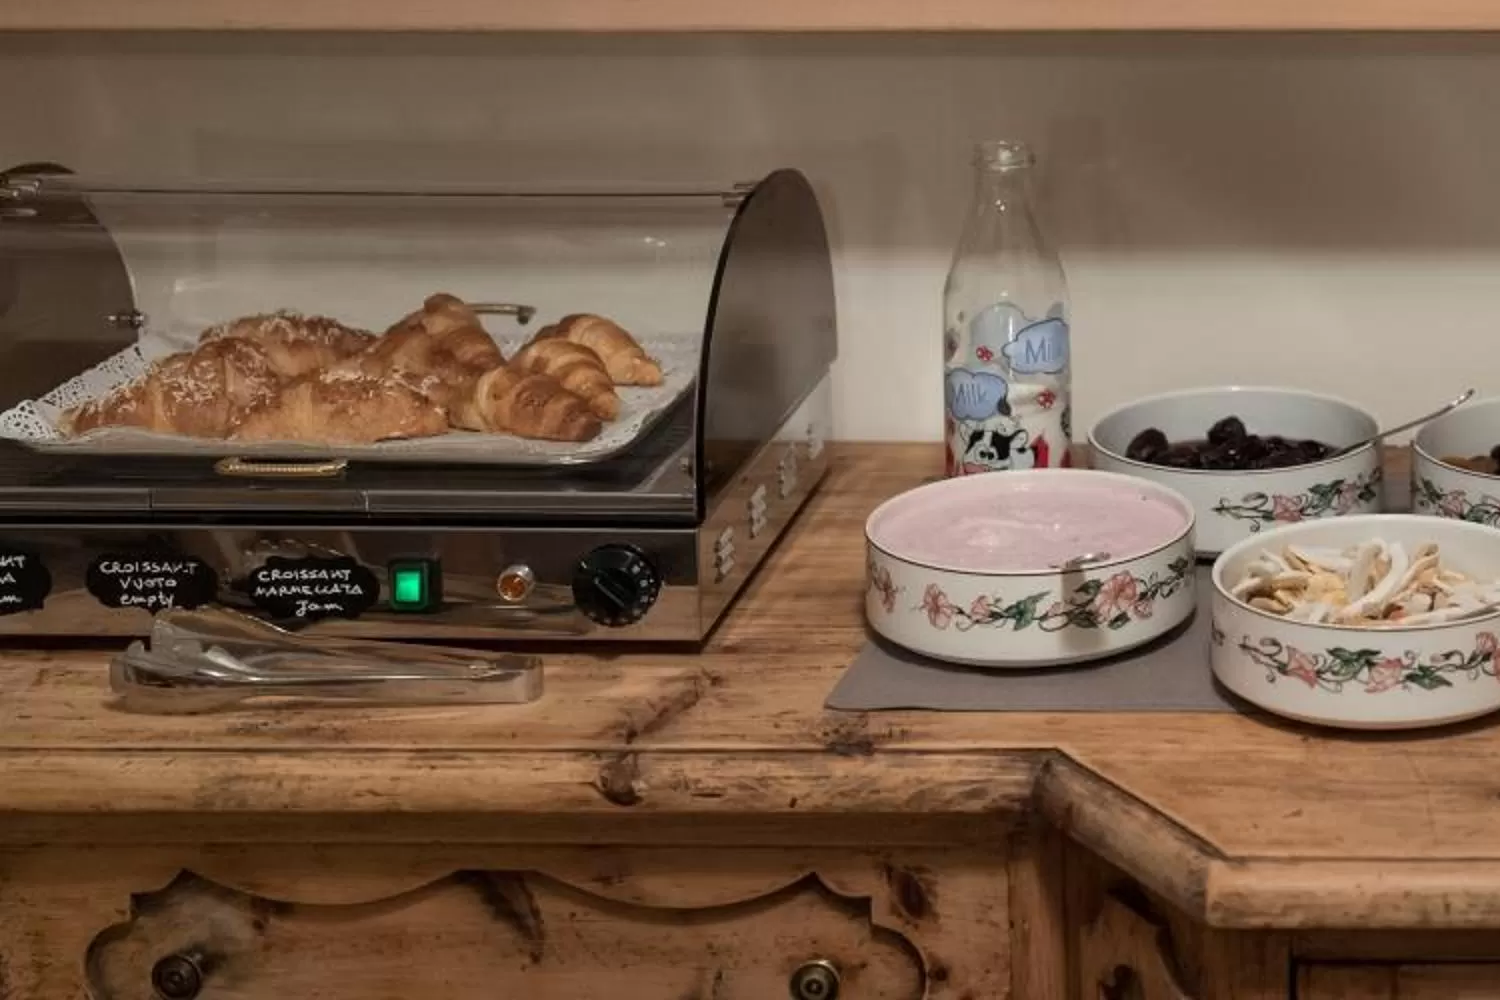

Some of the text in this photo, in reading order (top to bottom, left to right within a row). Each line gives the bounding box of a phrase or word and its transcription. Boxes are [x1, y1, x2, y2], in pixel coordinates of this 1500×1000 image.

[98, 560, 202, 576] CROISSANT
[257, 567, 352, 582] CROISSANT
[119, 576, 178, 591] VUOTO
[119, 591, 175, 609] empty
